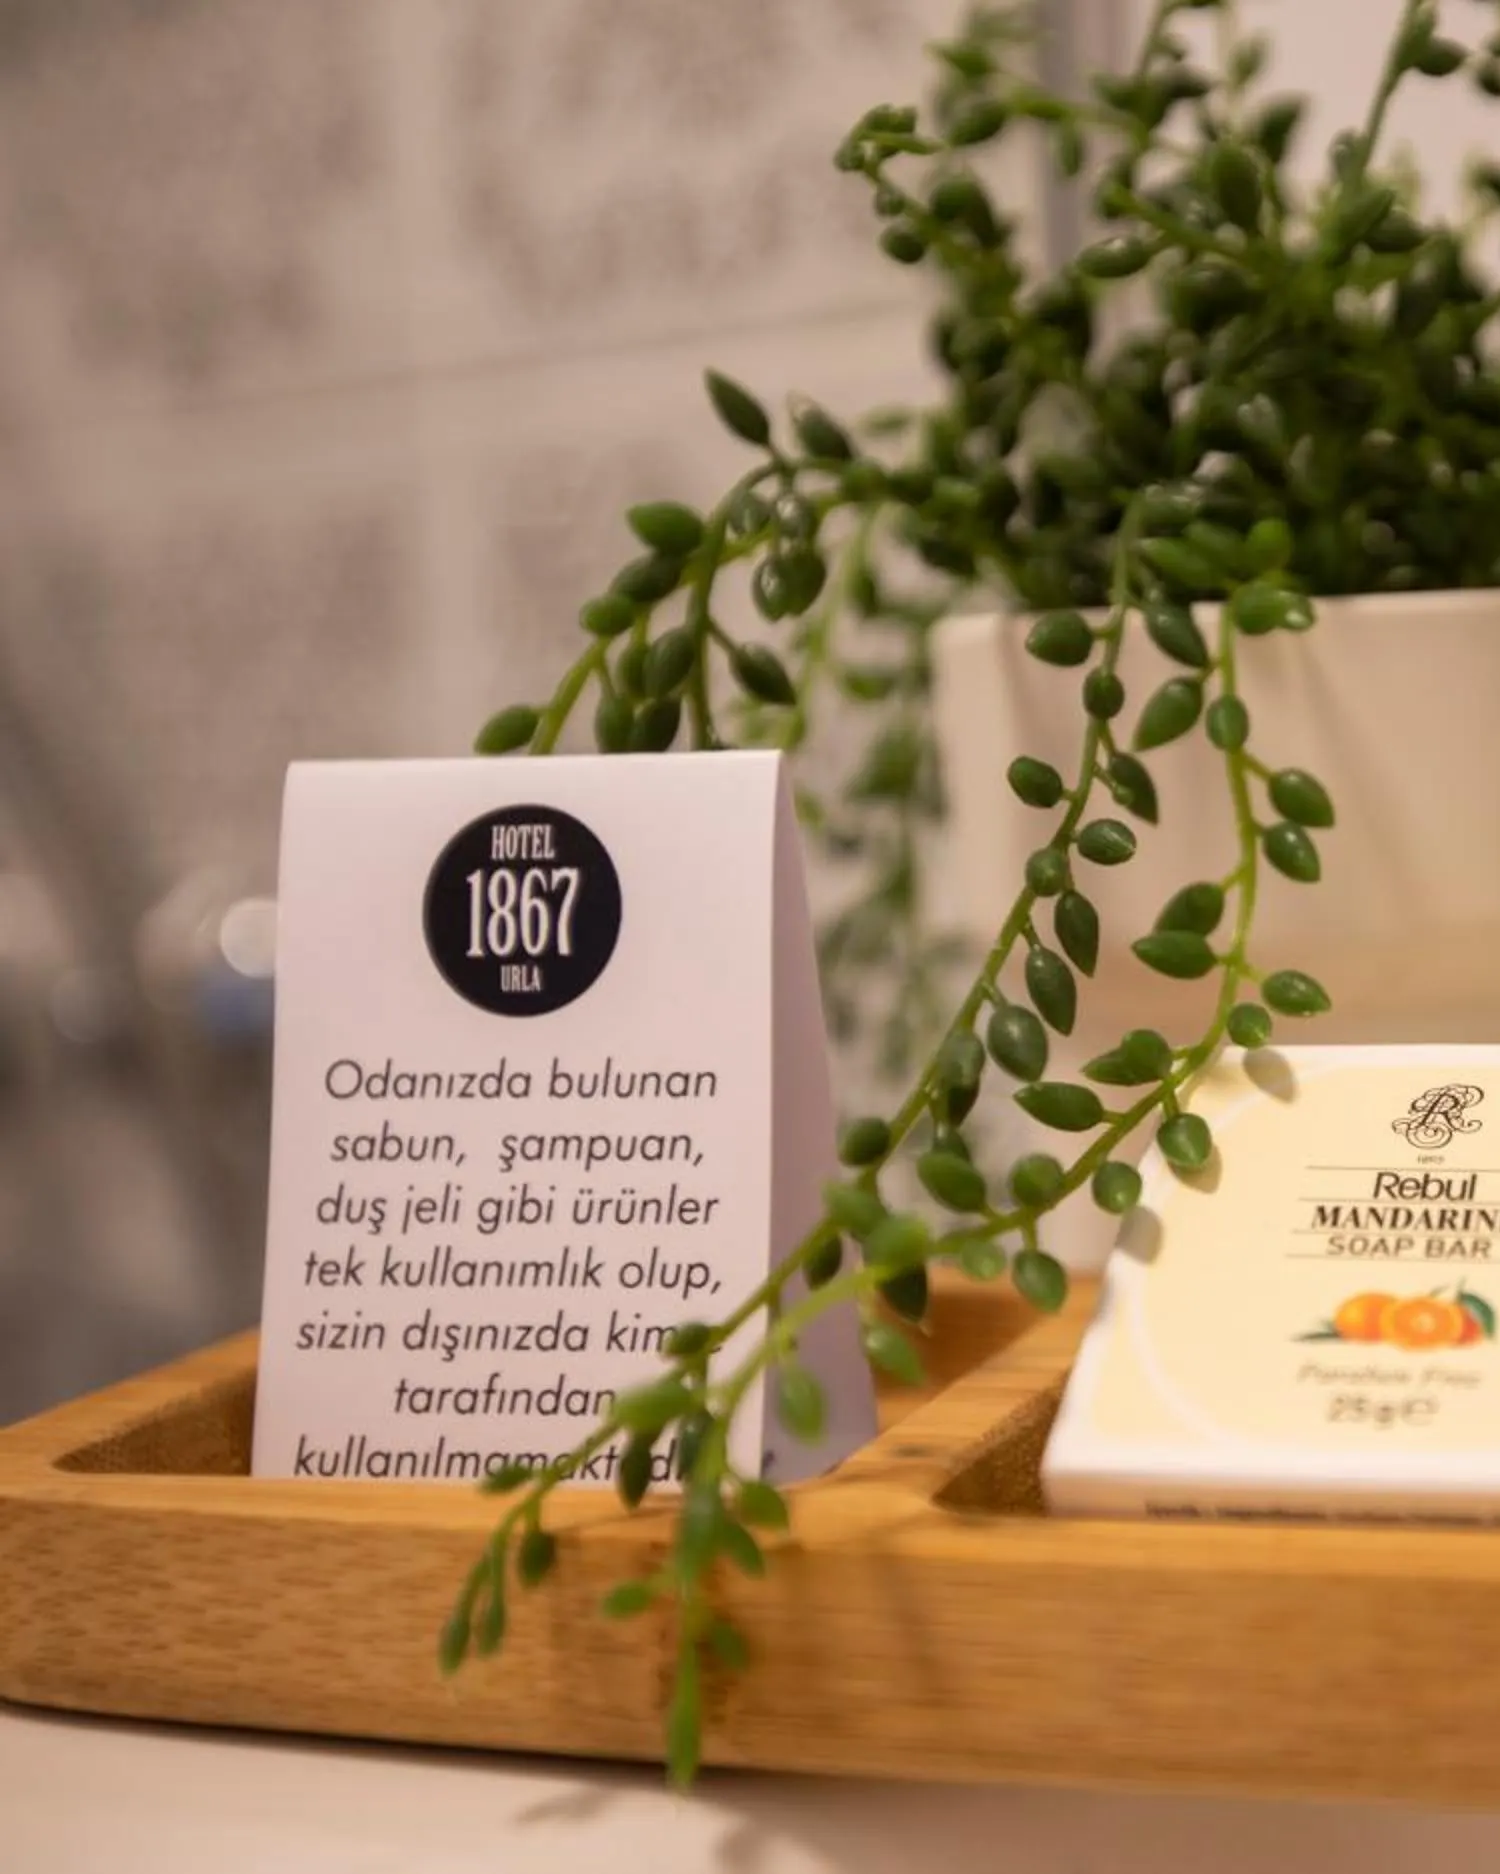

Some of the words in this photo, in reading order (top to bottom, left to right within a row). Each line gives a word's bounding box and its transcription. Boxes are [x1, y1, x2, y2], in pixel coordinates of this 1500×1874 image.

[491, 824, 555, 861] HOTEL
[466, 867, 579, 957] 1867
[501, 965, 542, 992] URLA
[325, 1058, 531, 1099] Odanızda
[548, 1057, 717, 1099] bulunan
[331, 1120, 467, 1166] sabun,
[499, 1134, 704, 1173] şampuan,
[317, 1182, 387, 1234] duş
[401, 1183, 463, 1234] jeli
[477, 1183, 556, 1234] gibi
[572, 1184, 719, 1225] ürünler
[1373, 1171, 1477, 1201] Rebul
[1326, 1234, 1414, 1257] SOAP
[1425, 1237, 1492, 1259] BAR
[304, 1245, 366, 1287] tek
[380, 1245, 603, 1288] kullanımlık
[619, 1246, 721, 1300] olup,
[296, 1310, 385, 1350] sizin
[402, 1309, 588, 1361] dışınızda
